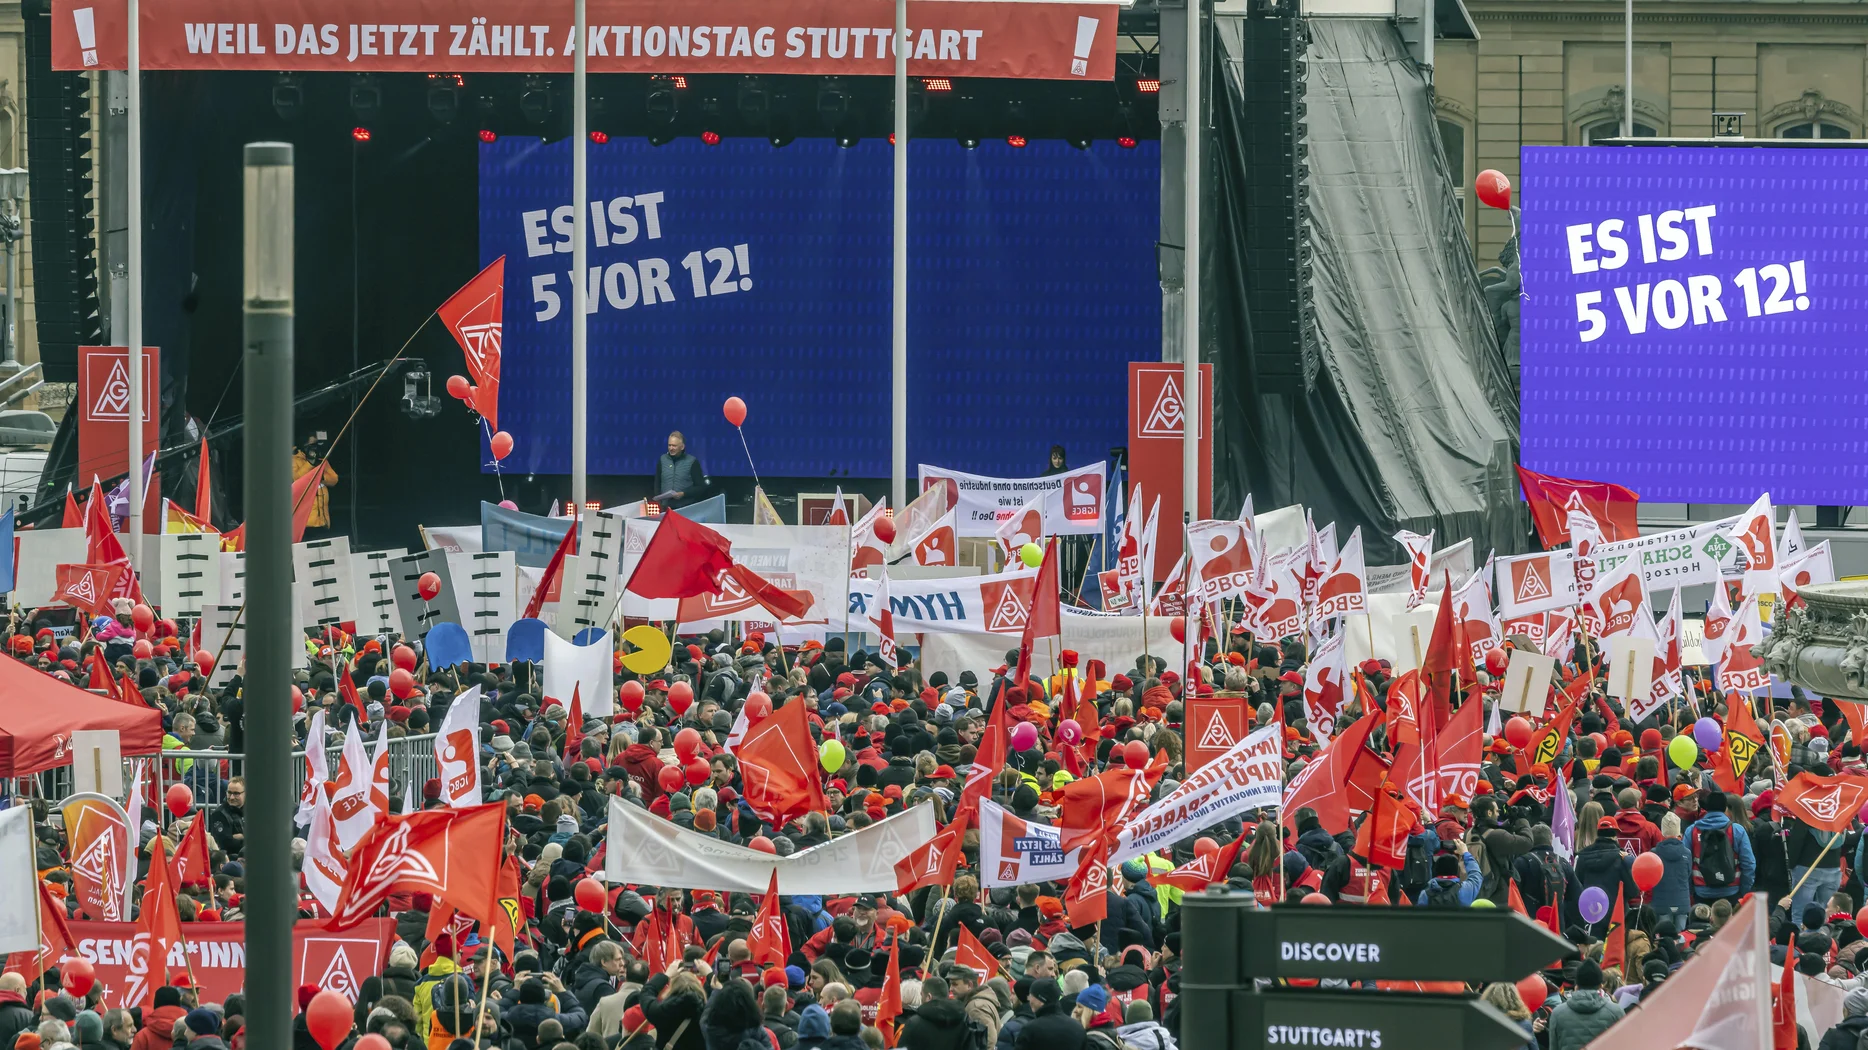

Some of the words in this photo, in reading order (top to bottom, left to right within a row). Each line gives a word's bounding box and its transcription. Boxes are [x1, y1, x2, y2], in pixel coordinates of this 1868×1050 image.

[185, 23, 265, 54] WEIL
[275, 23, 339, 55] DAS
[346, 24, 440, 62] JETZT
[449, 17, 554, 57] ZÄHLT.
[785, 26, 983, 61] STUTTGART
[522, 205, 574, 258] ES
[590, 191, 664, 247] IST
[1566, 218, 1629, 274] ES
[1638, 204, 1716, 264] IST
[532, 273, 561, 322] 5
[568, 258, 676, 315] VOR
[681, 243, 753, 298] 12!
[1576, 290, 1607, 342] 5
[1613, 274, 1728, 334] VOR
[1733, 259, 1810, 317] 12!
[1281, 941, 1380, 962] DISCOVER
[1267, 1025, 1382, 1048] STUTTGART'S
